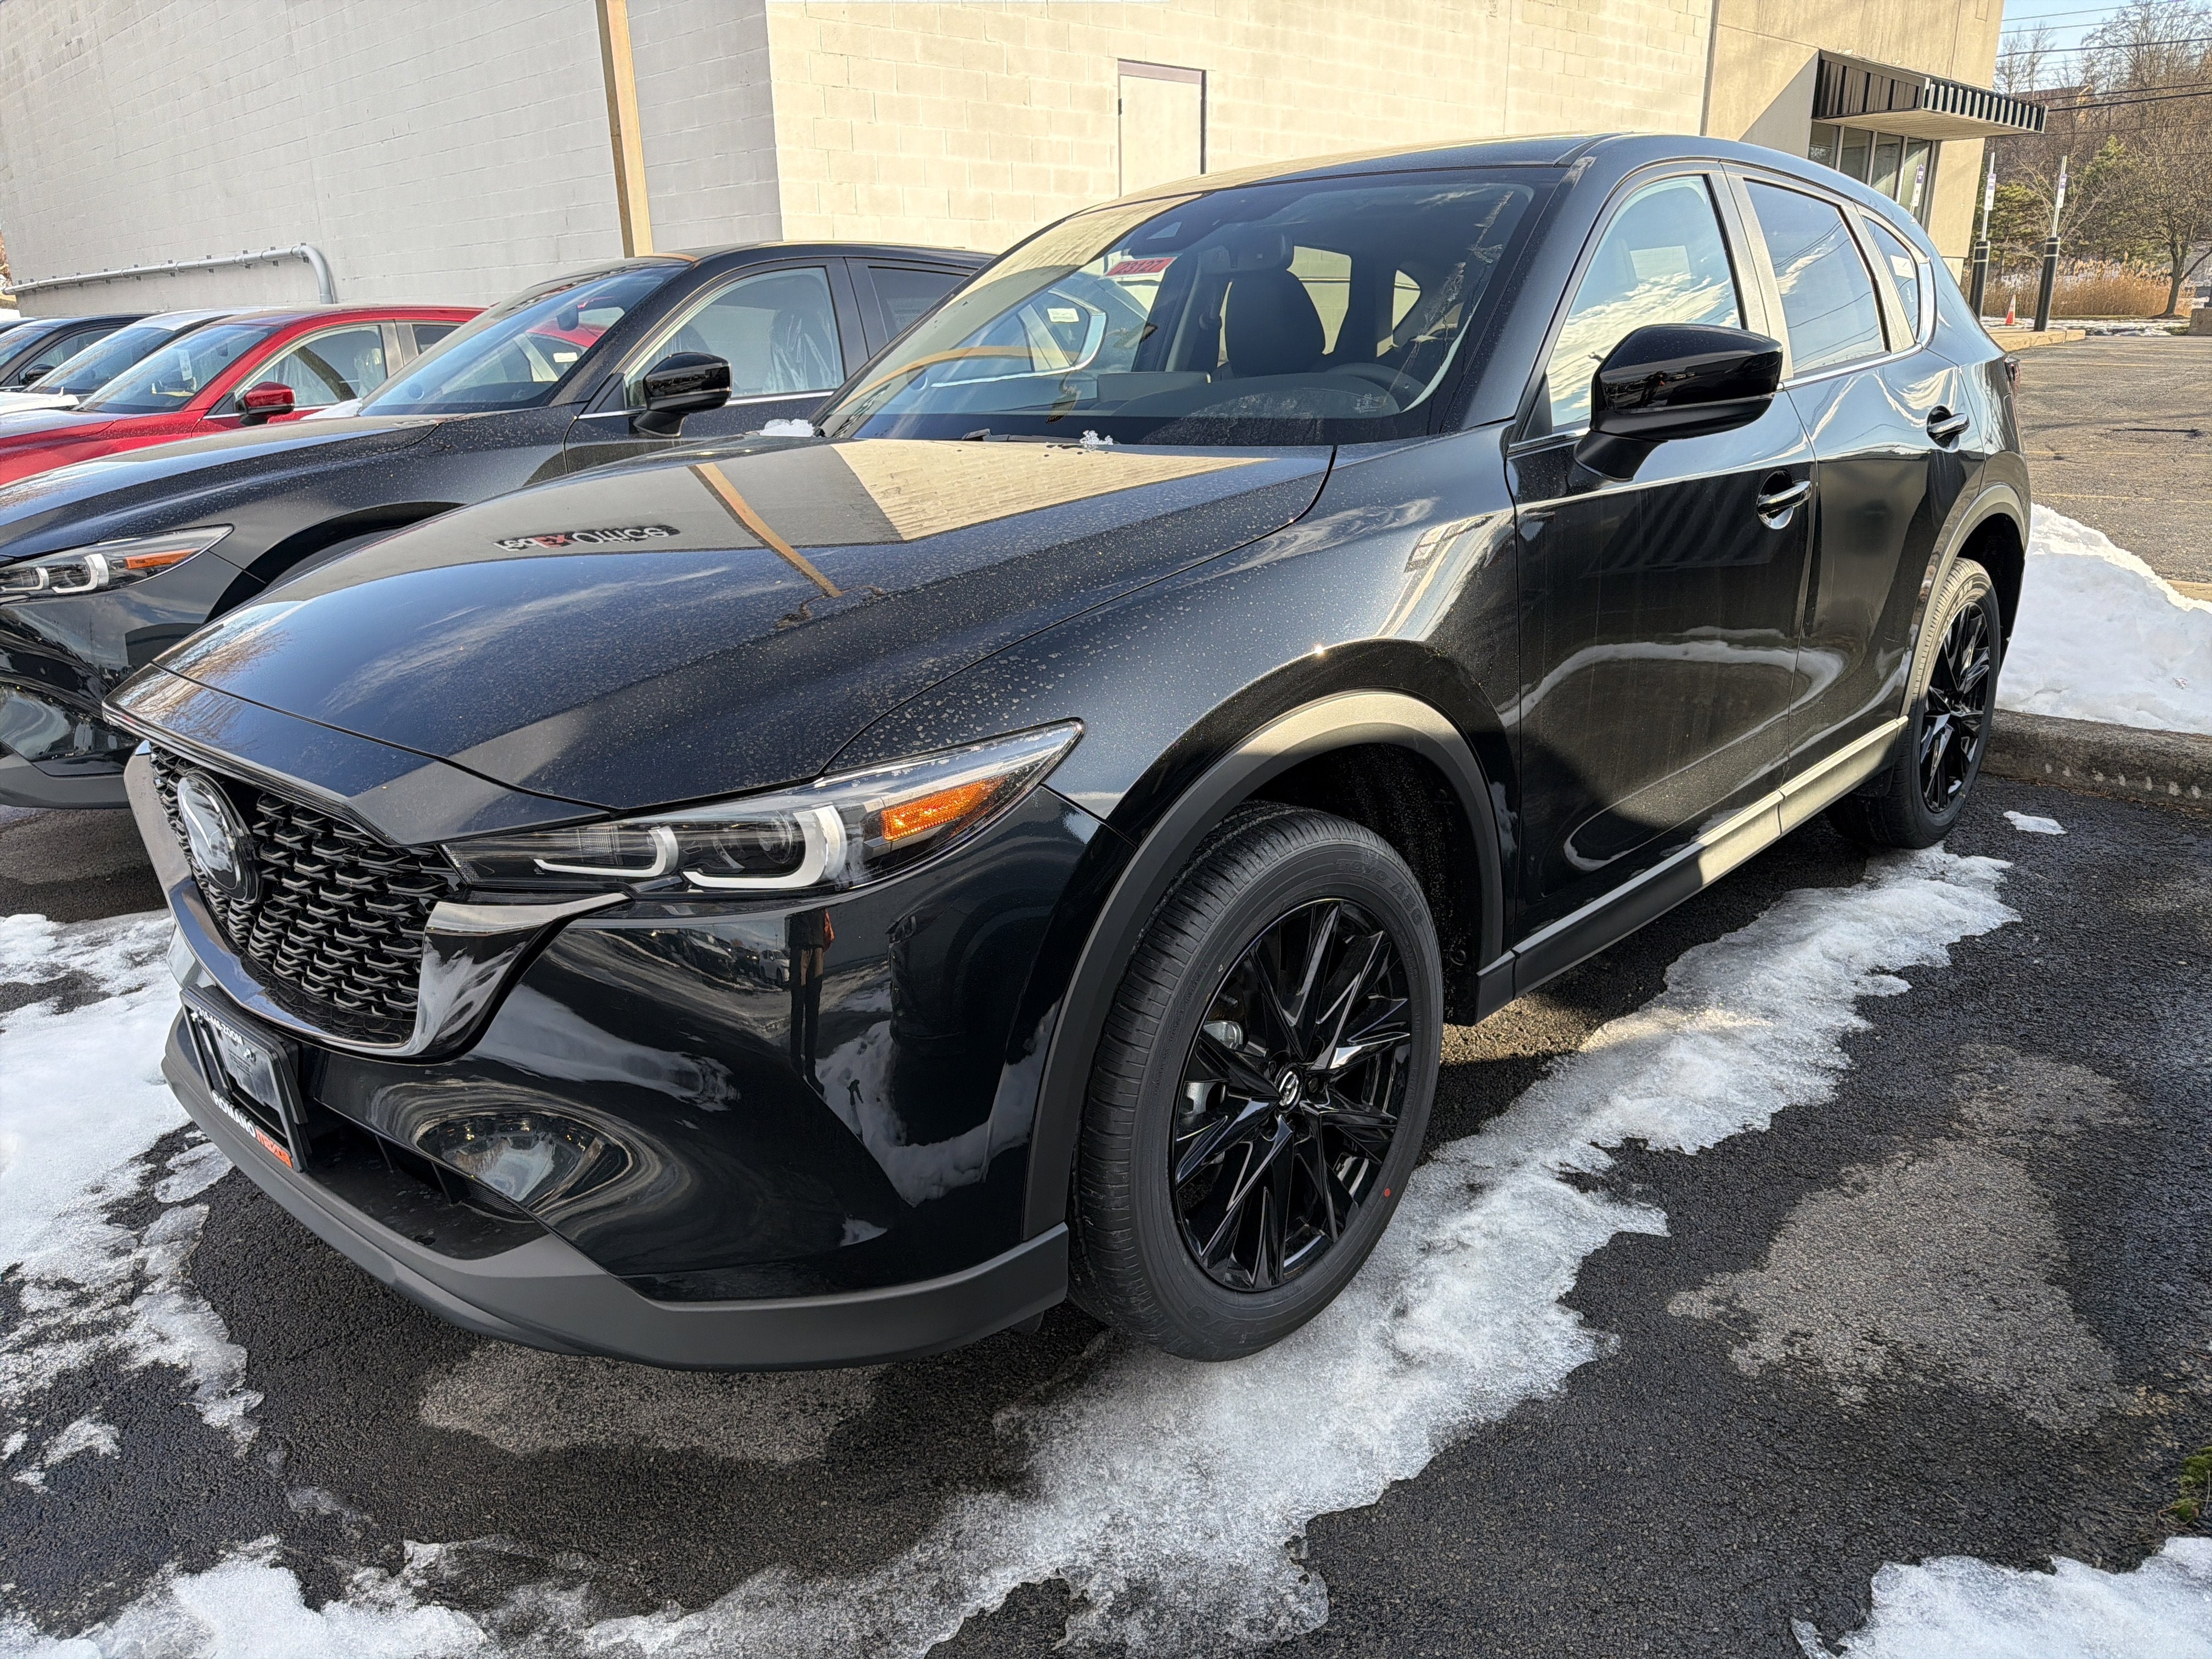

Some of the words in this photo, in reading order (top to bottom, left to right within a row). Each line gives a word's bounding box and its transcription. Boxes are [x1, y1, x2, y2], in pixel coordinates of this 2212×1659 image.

[1115, 261, 1164, 273] 23127
[1335, 859, 1387, 882] TOYO
[1390, 882, 1423, 926] A36
[212, 1092, 256, 1138] ROMANO
